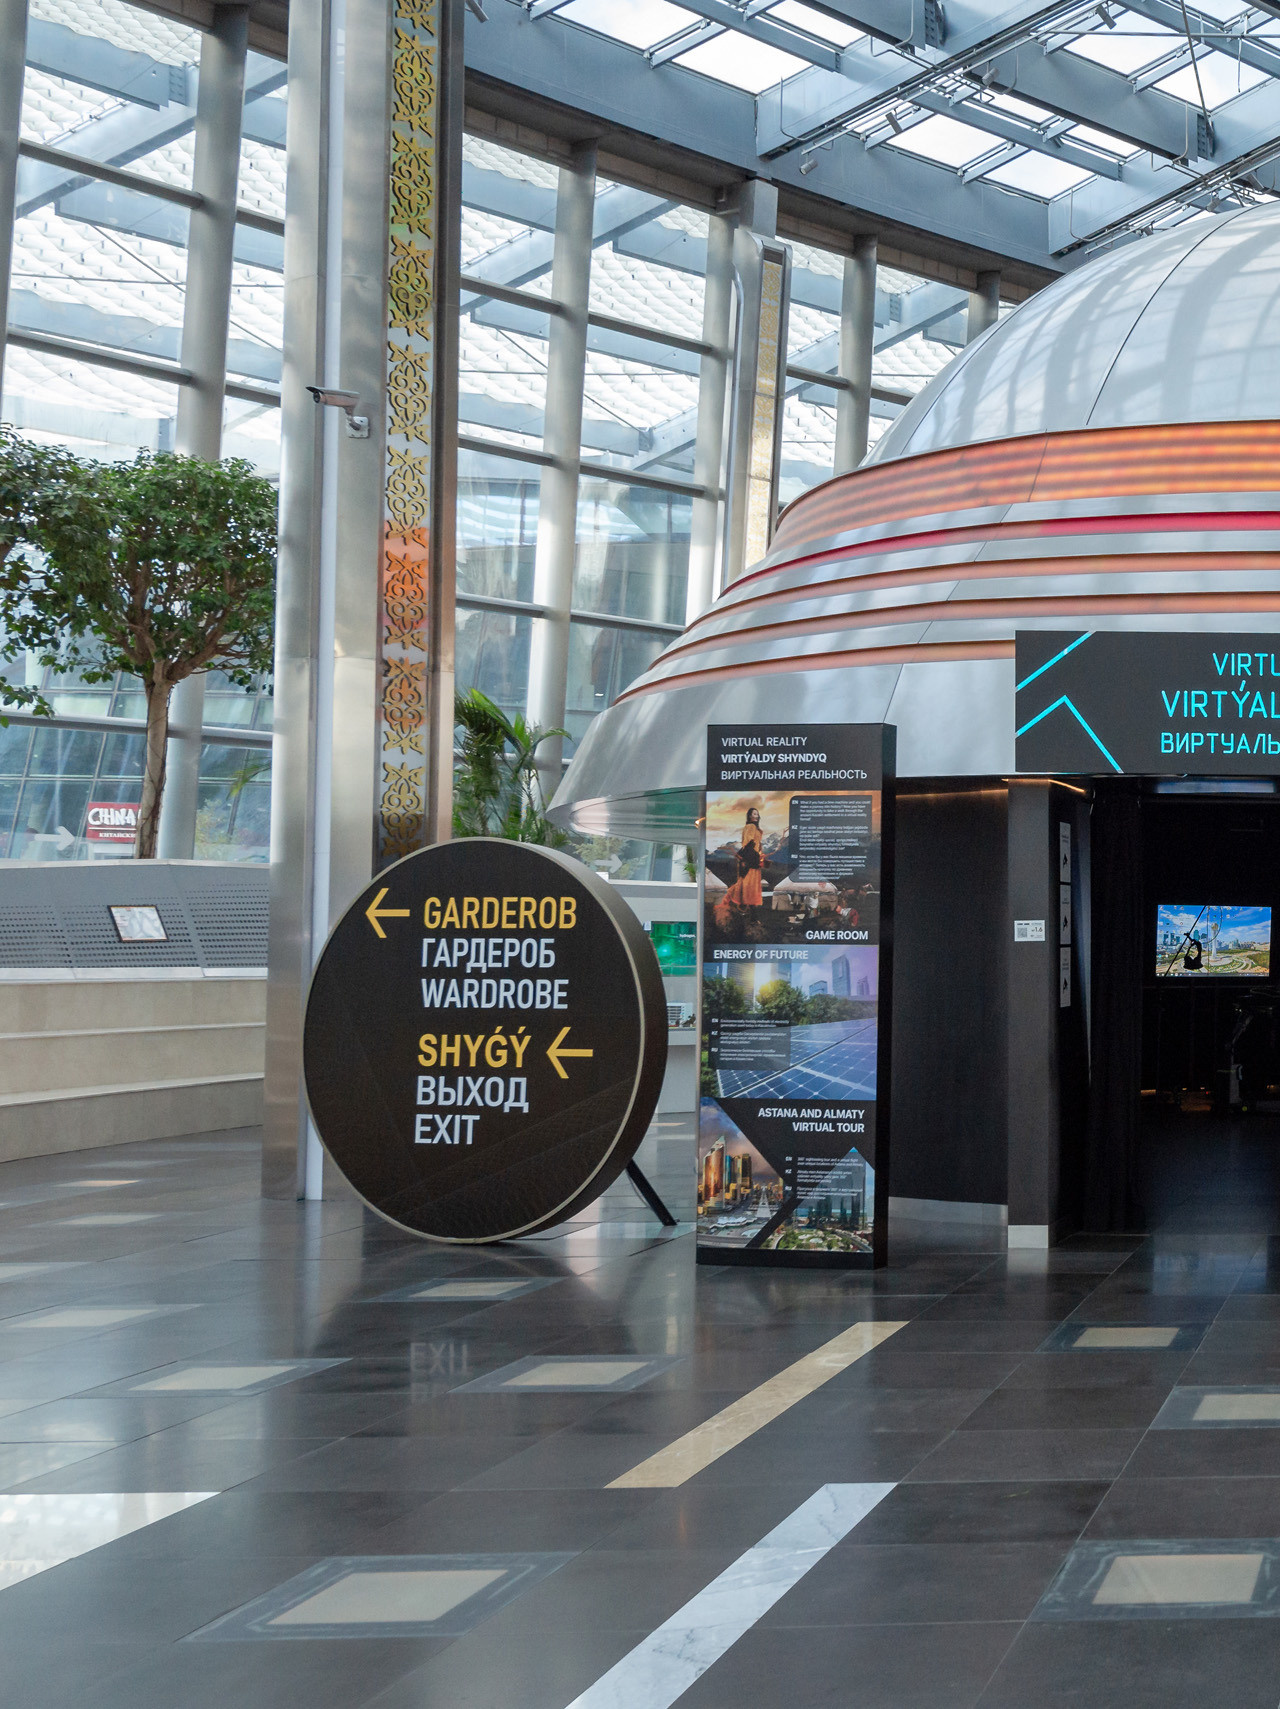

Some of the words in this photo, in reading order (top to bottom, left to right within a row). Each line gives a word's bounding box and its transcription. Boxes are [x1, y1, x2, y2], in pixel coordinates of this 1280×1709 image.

[721, 737, 763, 747] VIRTUAL
[766, 737, 807, 747] REALITY
[721, 751, 775, 763] VIRTÝALDY
[777, 753, 827, 763] SHYNDYQ
[721, 770, 795, 780] ВИРТУАЛЬНАЯ
[798, 769, 868, 780] РЕАЛЬНОСТЬ
[424, 897, 577, 929] GARDEROB
[805, 930, 835, 940] GAME
[837, 930, 869, 940] ROOM
[420, 938, 556, 974] ГАРДЕРОБ
[713, 950, 753, 959] ENERGY
[754, 950, 768, 960] OF
[770, 950, 808, 960] FUTURE
[421, 978, 569, 1010] WARDROBE
[417, 1026, 532, 1068] SHYǴÝ
[416, 1075, 529, 1113] ВЫХОД
[758, 1107, 798, 1118] ASTANA
[800, 1108, 822, 1118] AND
[823, 1109, 865, 1119] ALMATY
[414, 1114, 480, 1145] EXIT
[792, 1122, 835, 1132] VIRTUAL
[837, 1123, 865, 1133] TOUR
